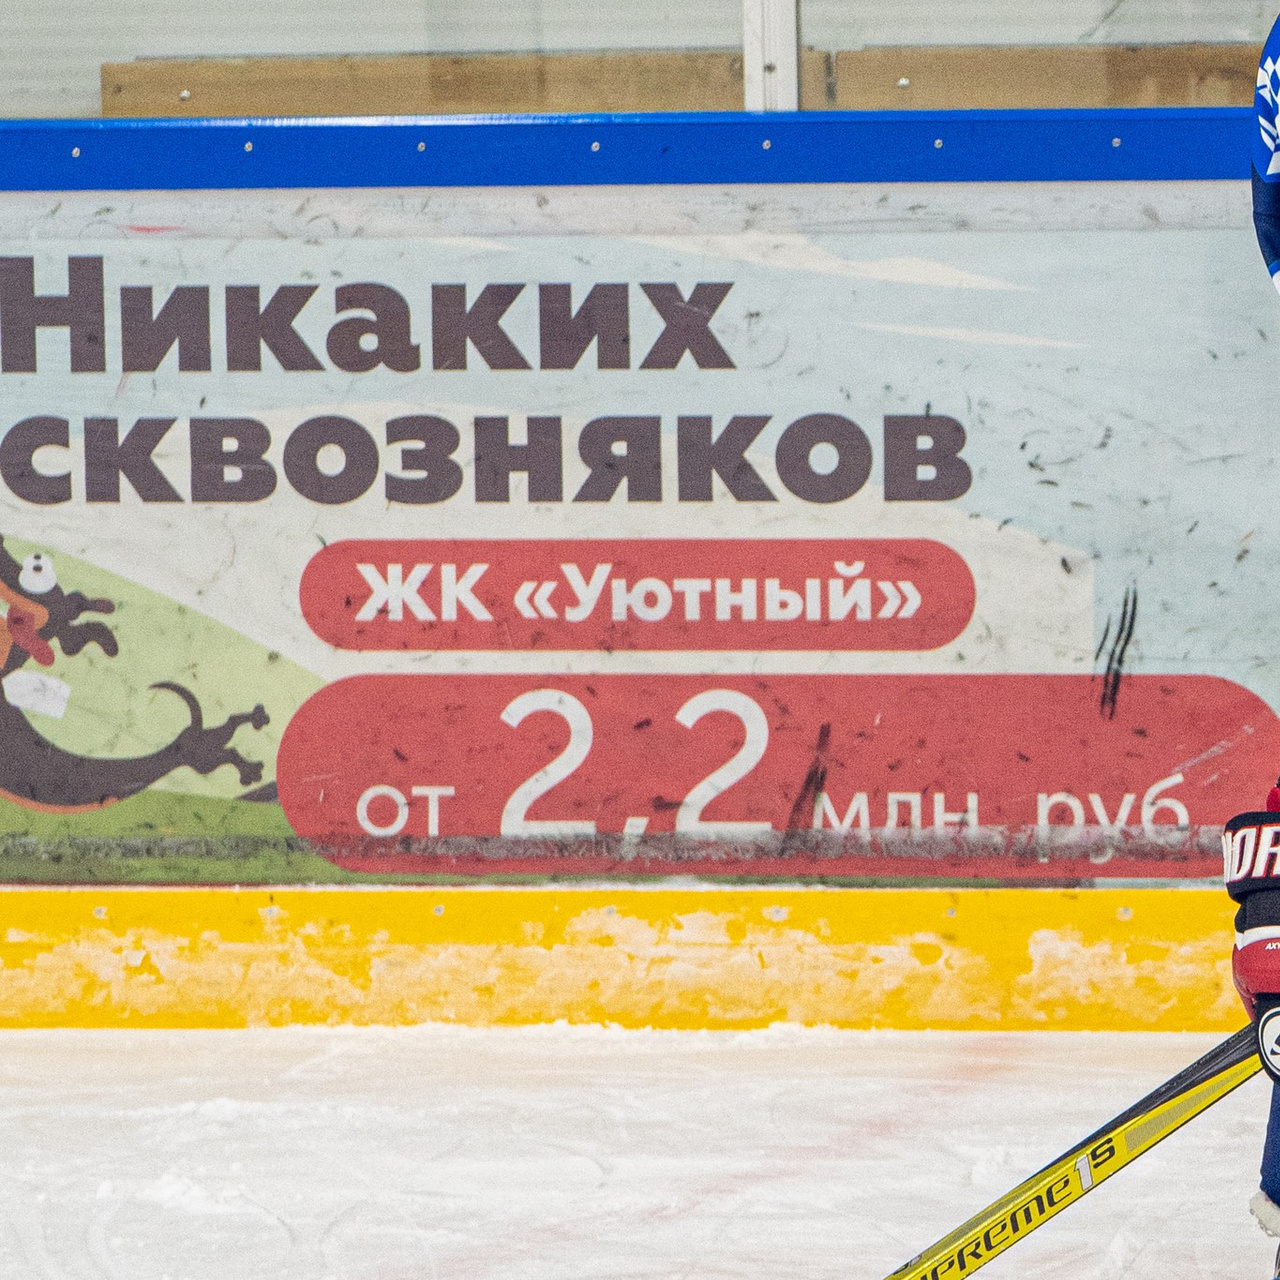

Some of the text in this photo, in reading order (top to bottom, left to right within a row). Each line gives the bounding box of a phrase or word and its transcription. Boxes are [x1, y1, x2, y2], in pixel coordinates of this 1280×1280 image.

[0, 255, 736, 374] Никаких
[0, 413, 973, 504] сквозняков
[355, 560, 922, 623] ЖК «Уютный»
[355, 784, 455, 839] от
[501, 688, 772, 860] 2,2
[812, 792, 979, 841] млн
